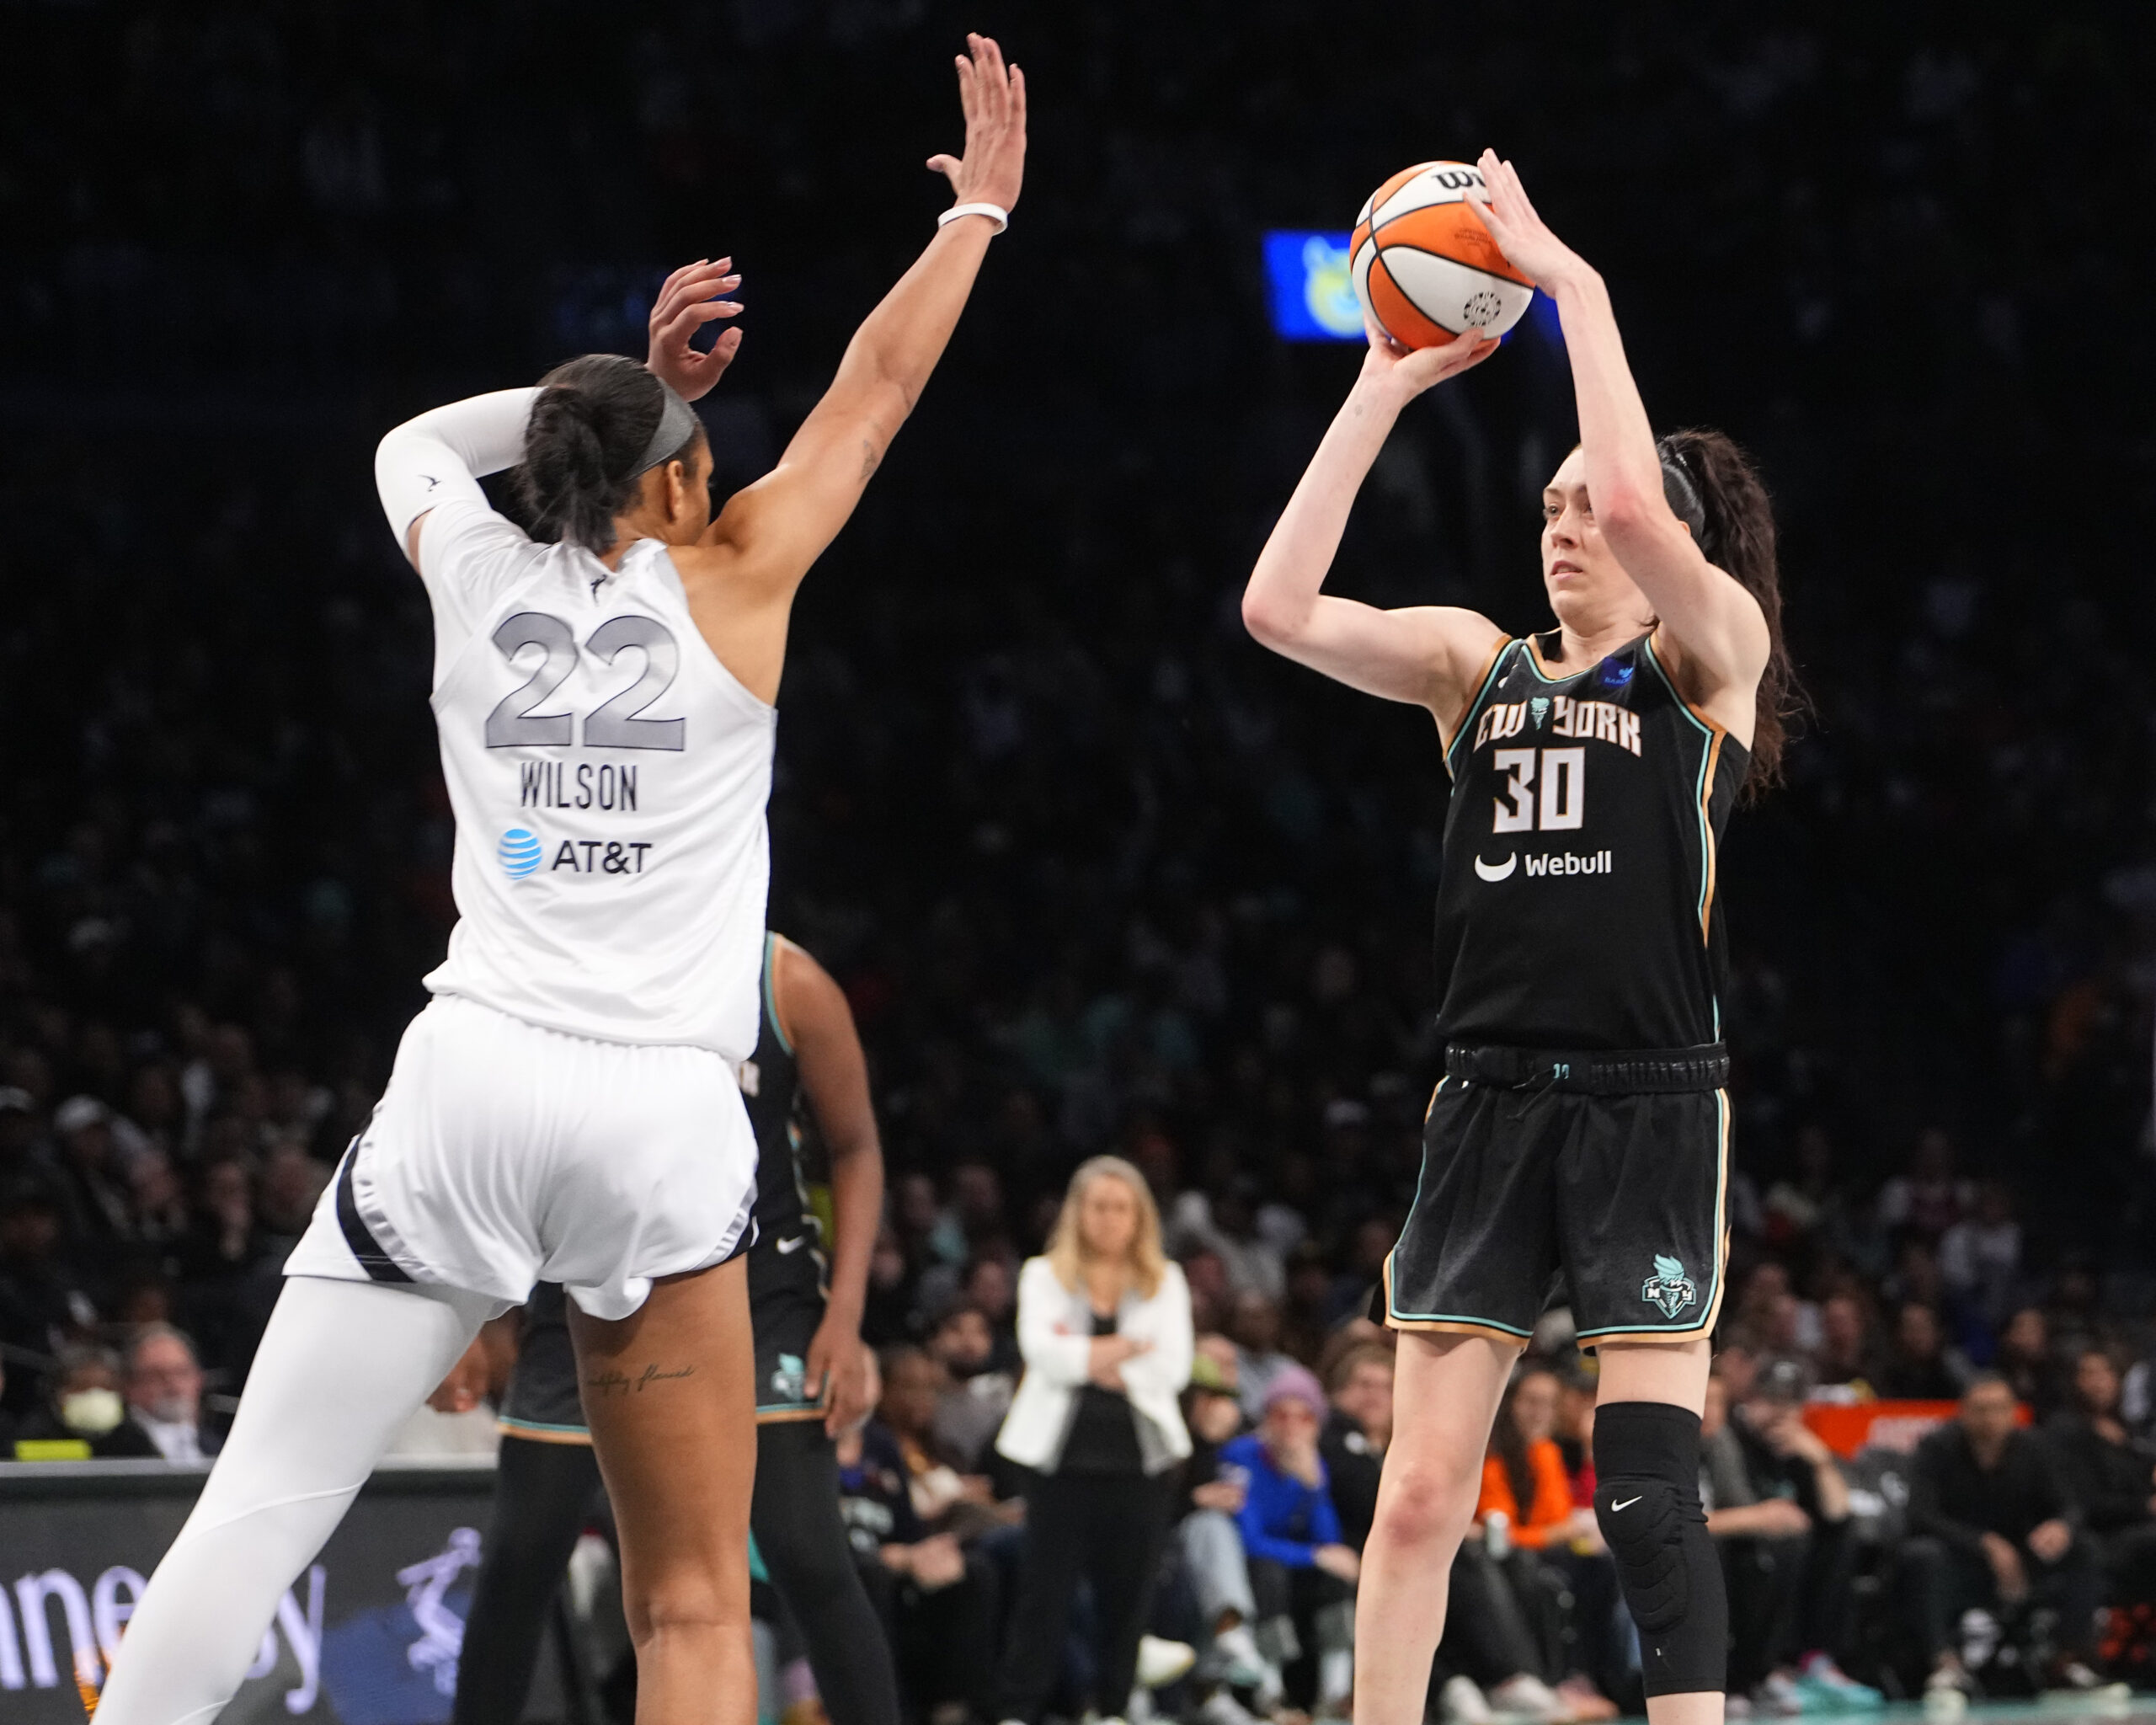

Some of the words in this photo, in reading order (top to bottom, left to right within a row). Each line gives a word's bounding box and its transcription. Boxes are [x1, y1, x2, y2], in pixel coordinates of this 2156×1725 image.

[485, 611, 686, 751] 22
[1473, 700, 1528, 753] EW
[1552, 695, 1641, 758] YORK
[520, 761, 638, 812] WILSON
[1492, 746, 1585, 834] 30
[551, 840, 653, 874] AT&T
[1524, 850, 1612, 877] Webull
